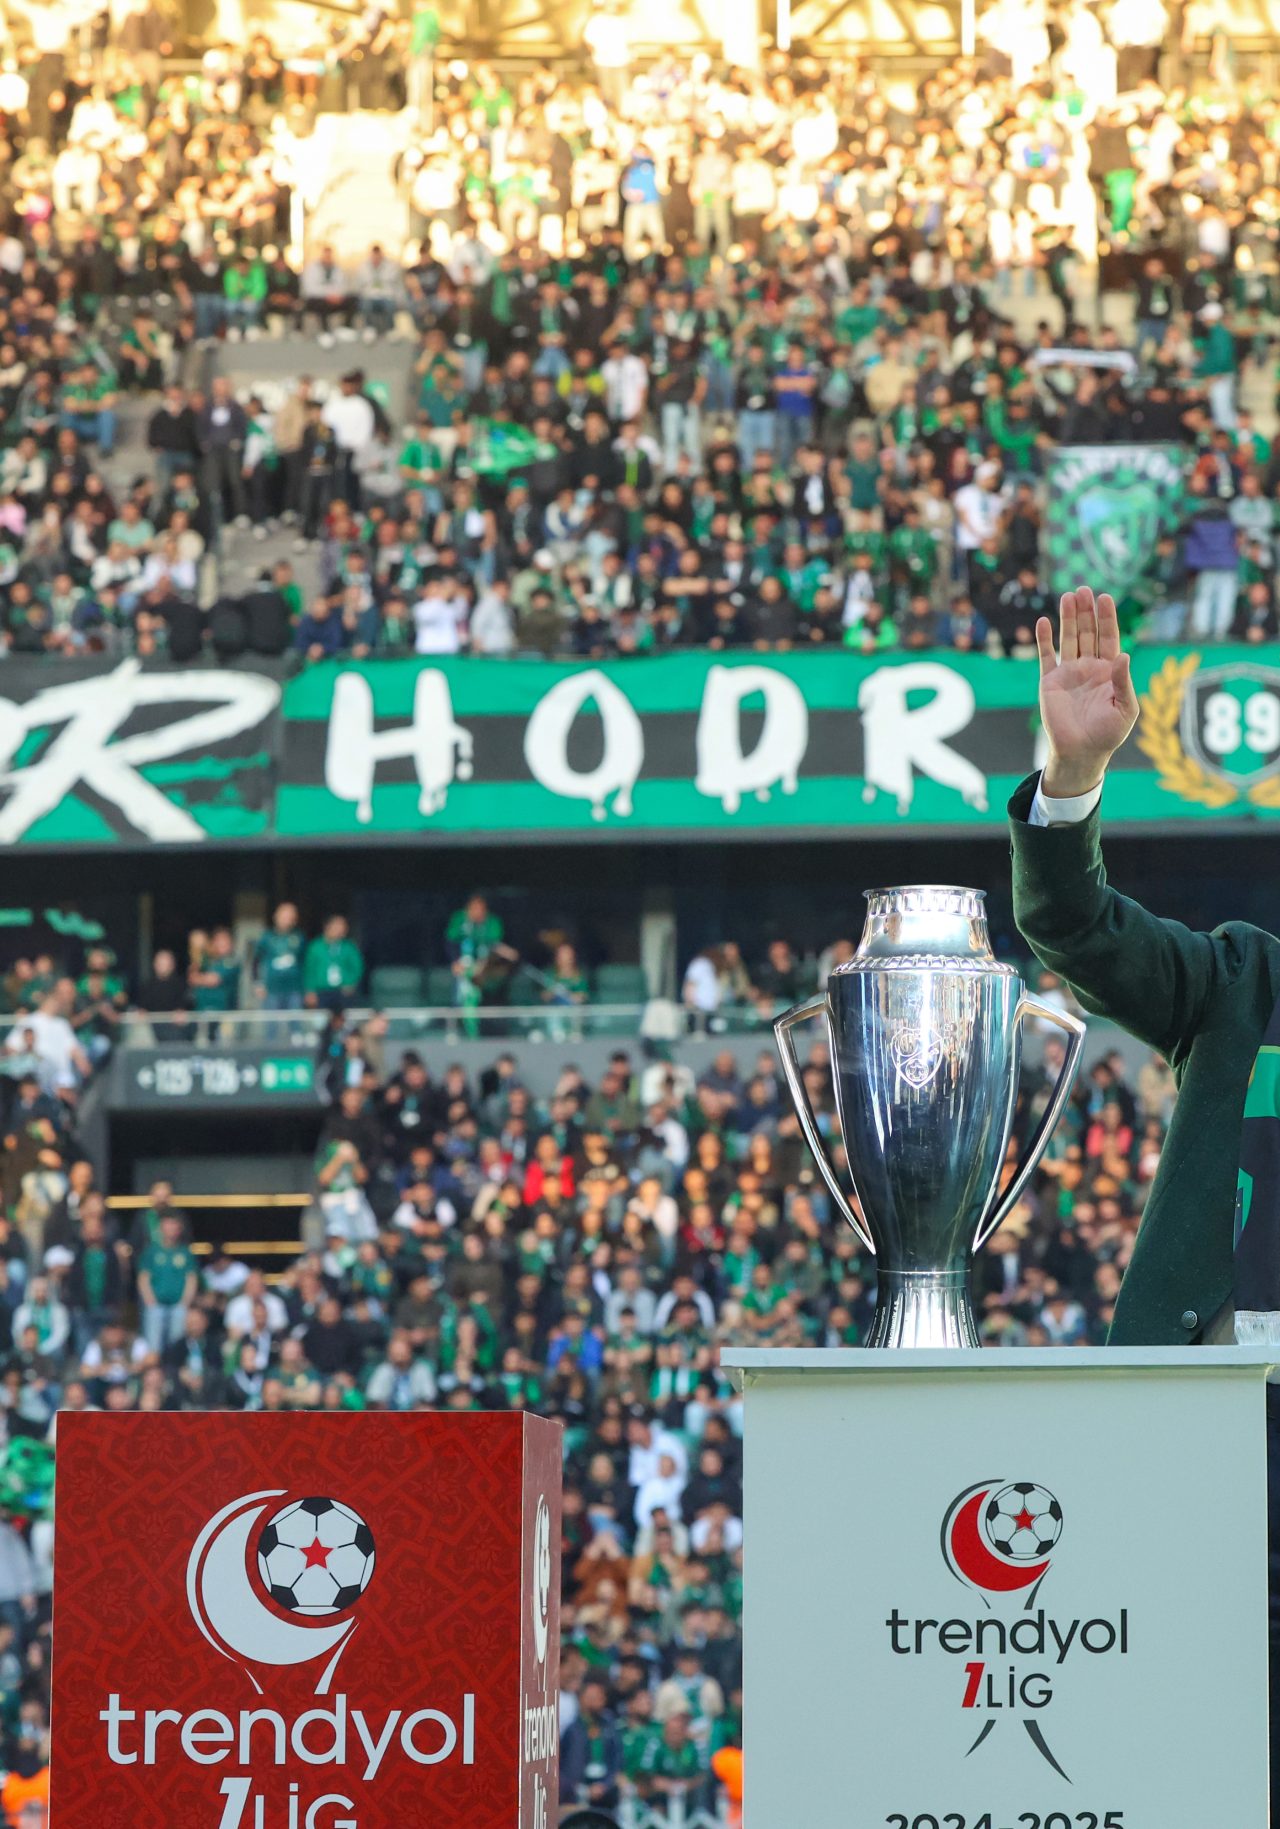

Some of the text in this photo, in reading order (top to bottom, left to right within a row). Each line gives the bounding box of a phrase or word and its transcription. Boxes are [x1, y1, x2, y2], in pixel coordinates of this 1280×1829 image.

[325, 662, 1050, 824] HODR
[886, 1608, 1128, 1664] trendyol
[99, 1693, 475, 1781] trendyol
[525, 1689, 557, 1774] trendyol
